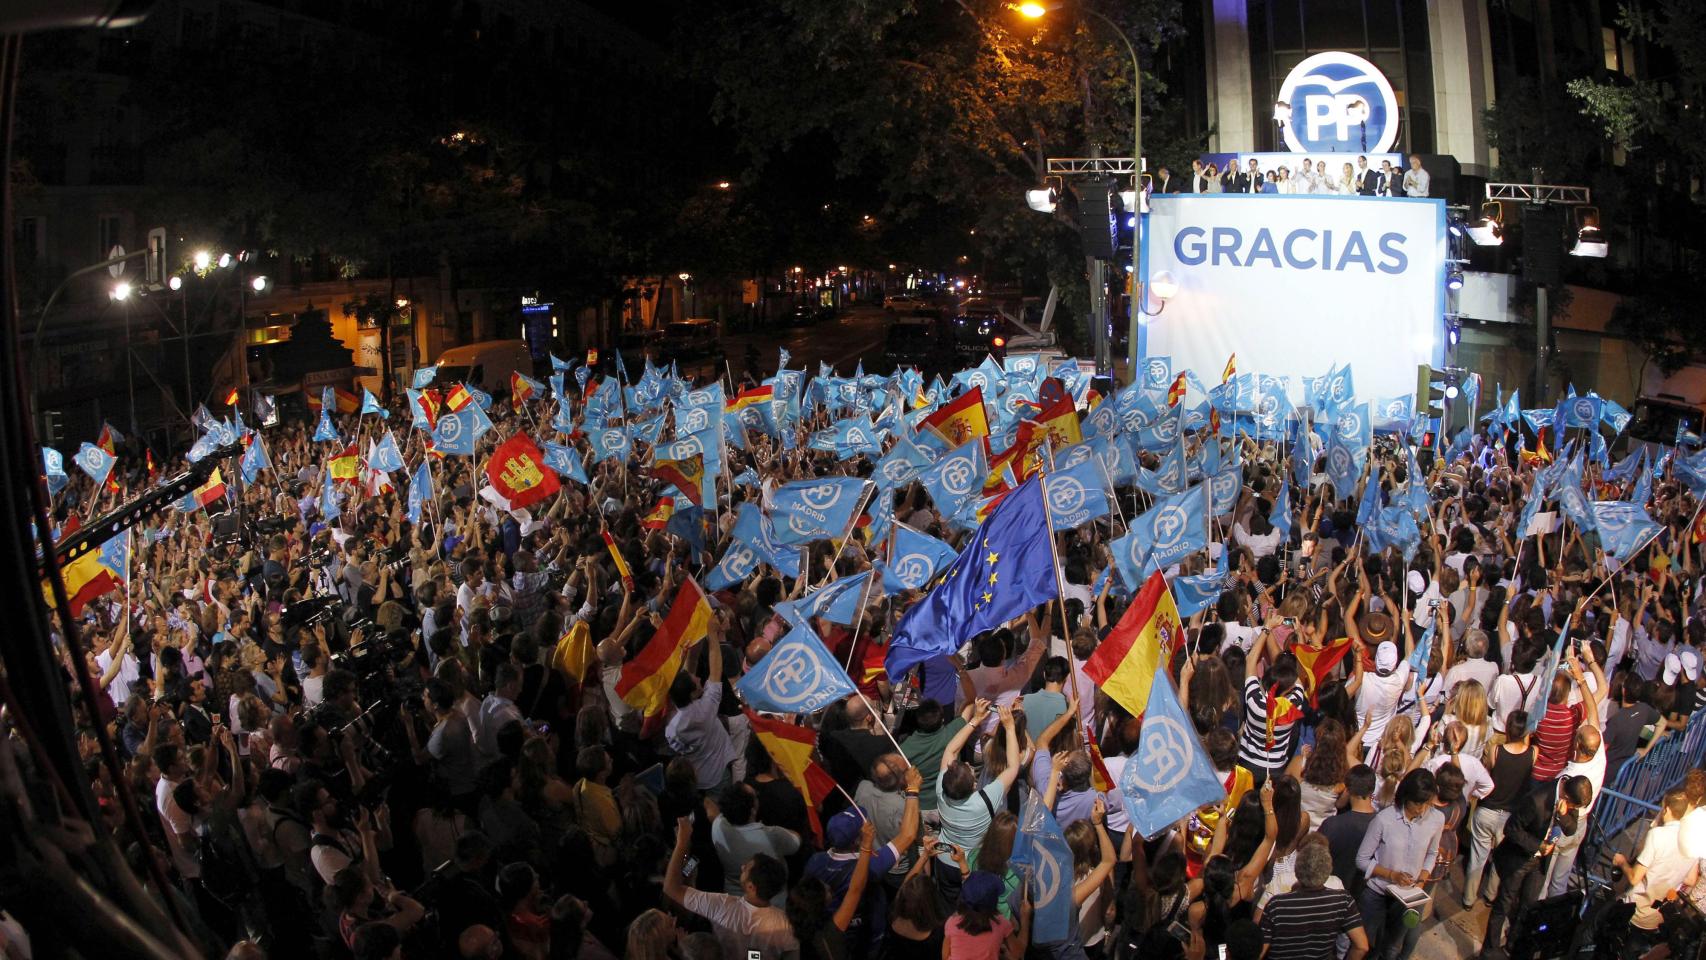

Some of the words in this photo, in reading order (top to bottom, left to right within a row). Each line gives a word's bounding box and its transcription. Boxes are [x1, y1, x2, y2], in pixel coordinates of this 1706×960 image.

[1306, 94, 1370, 141] PP
[1173, 226, 1409, 275] GRACIAS
[442, 422, 456, 434] PP
[676, 444, 697, 460] PP
[949, 466, 970, 488] PP
[1053, 488, 1076, 509] PP
[1213, 481, 1233, 496] PP
[792, 502, 826, 522] MADRID
[1056, 508, 1090, 526] MADRID
[773, 656, 806, 695] PP
